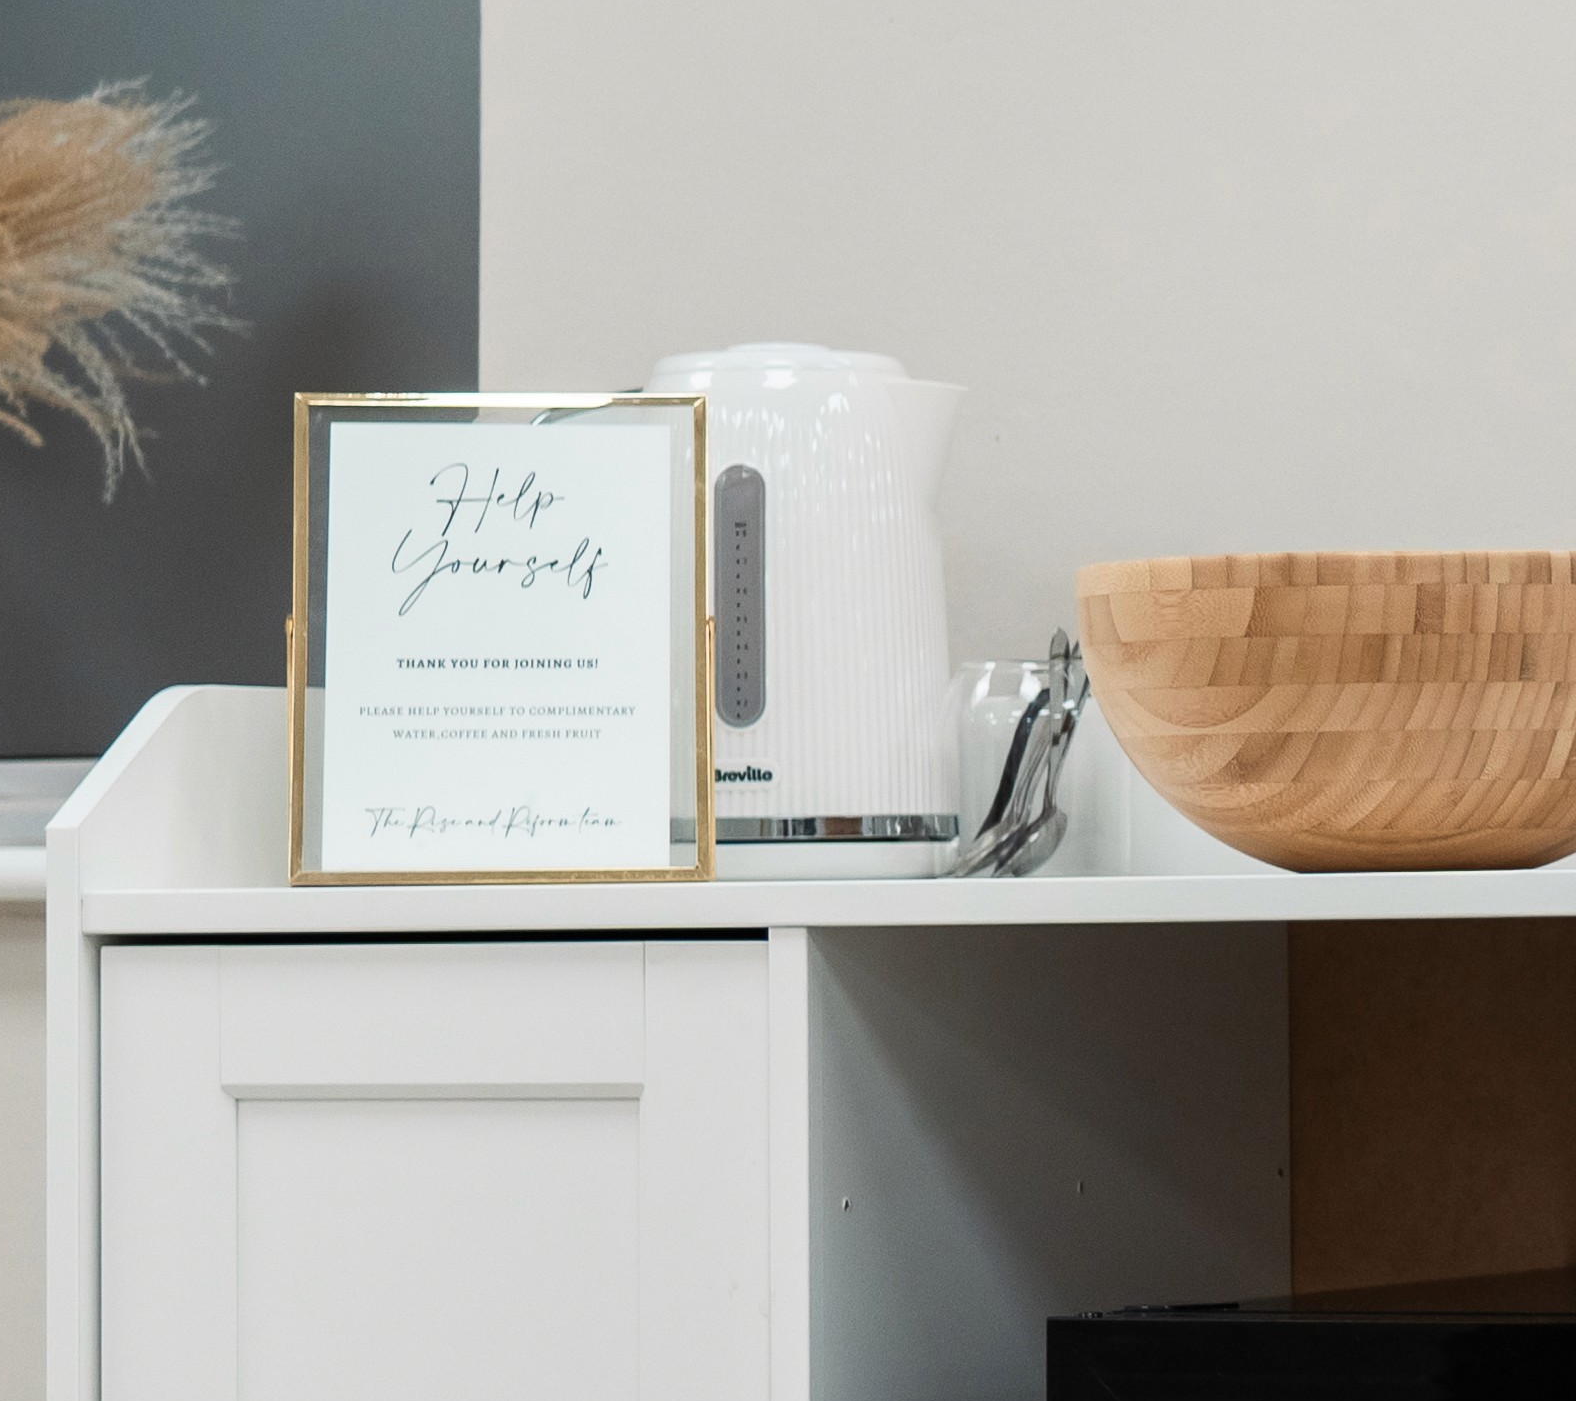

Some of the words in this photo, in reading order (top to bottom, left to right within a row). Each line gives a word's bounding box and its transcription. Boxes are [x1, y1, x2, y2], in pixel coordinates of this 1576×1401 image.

[429, 462, 565, 537] Help
[391, 528, 609, 617] Yourself
[396, 657, 446, 670] THANK
[450, 657, 479, 670] YOU
[483, 657, 510, 670] FOR
[514, 657, 572, 671] JOINING
[577, 657, 600, 670] US!
[359, 705, 404, 717] PLEASE
[407, 705, 440, 717] HELP
[443, 705, 506, 717] YOURSELF
[509, 705, 526, 717] TO
[528, 705, 637, 717] COMPLIMENTARY
[491, 728, 519, 740] AND
[522, 728, 562, 740] FRESH
[565, 728, 602, 740] FRUIT
[365, 806, 405, 838] The
